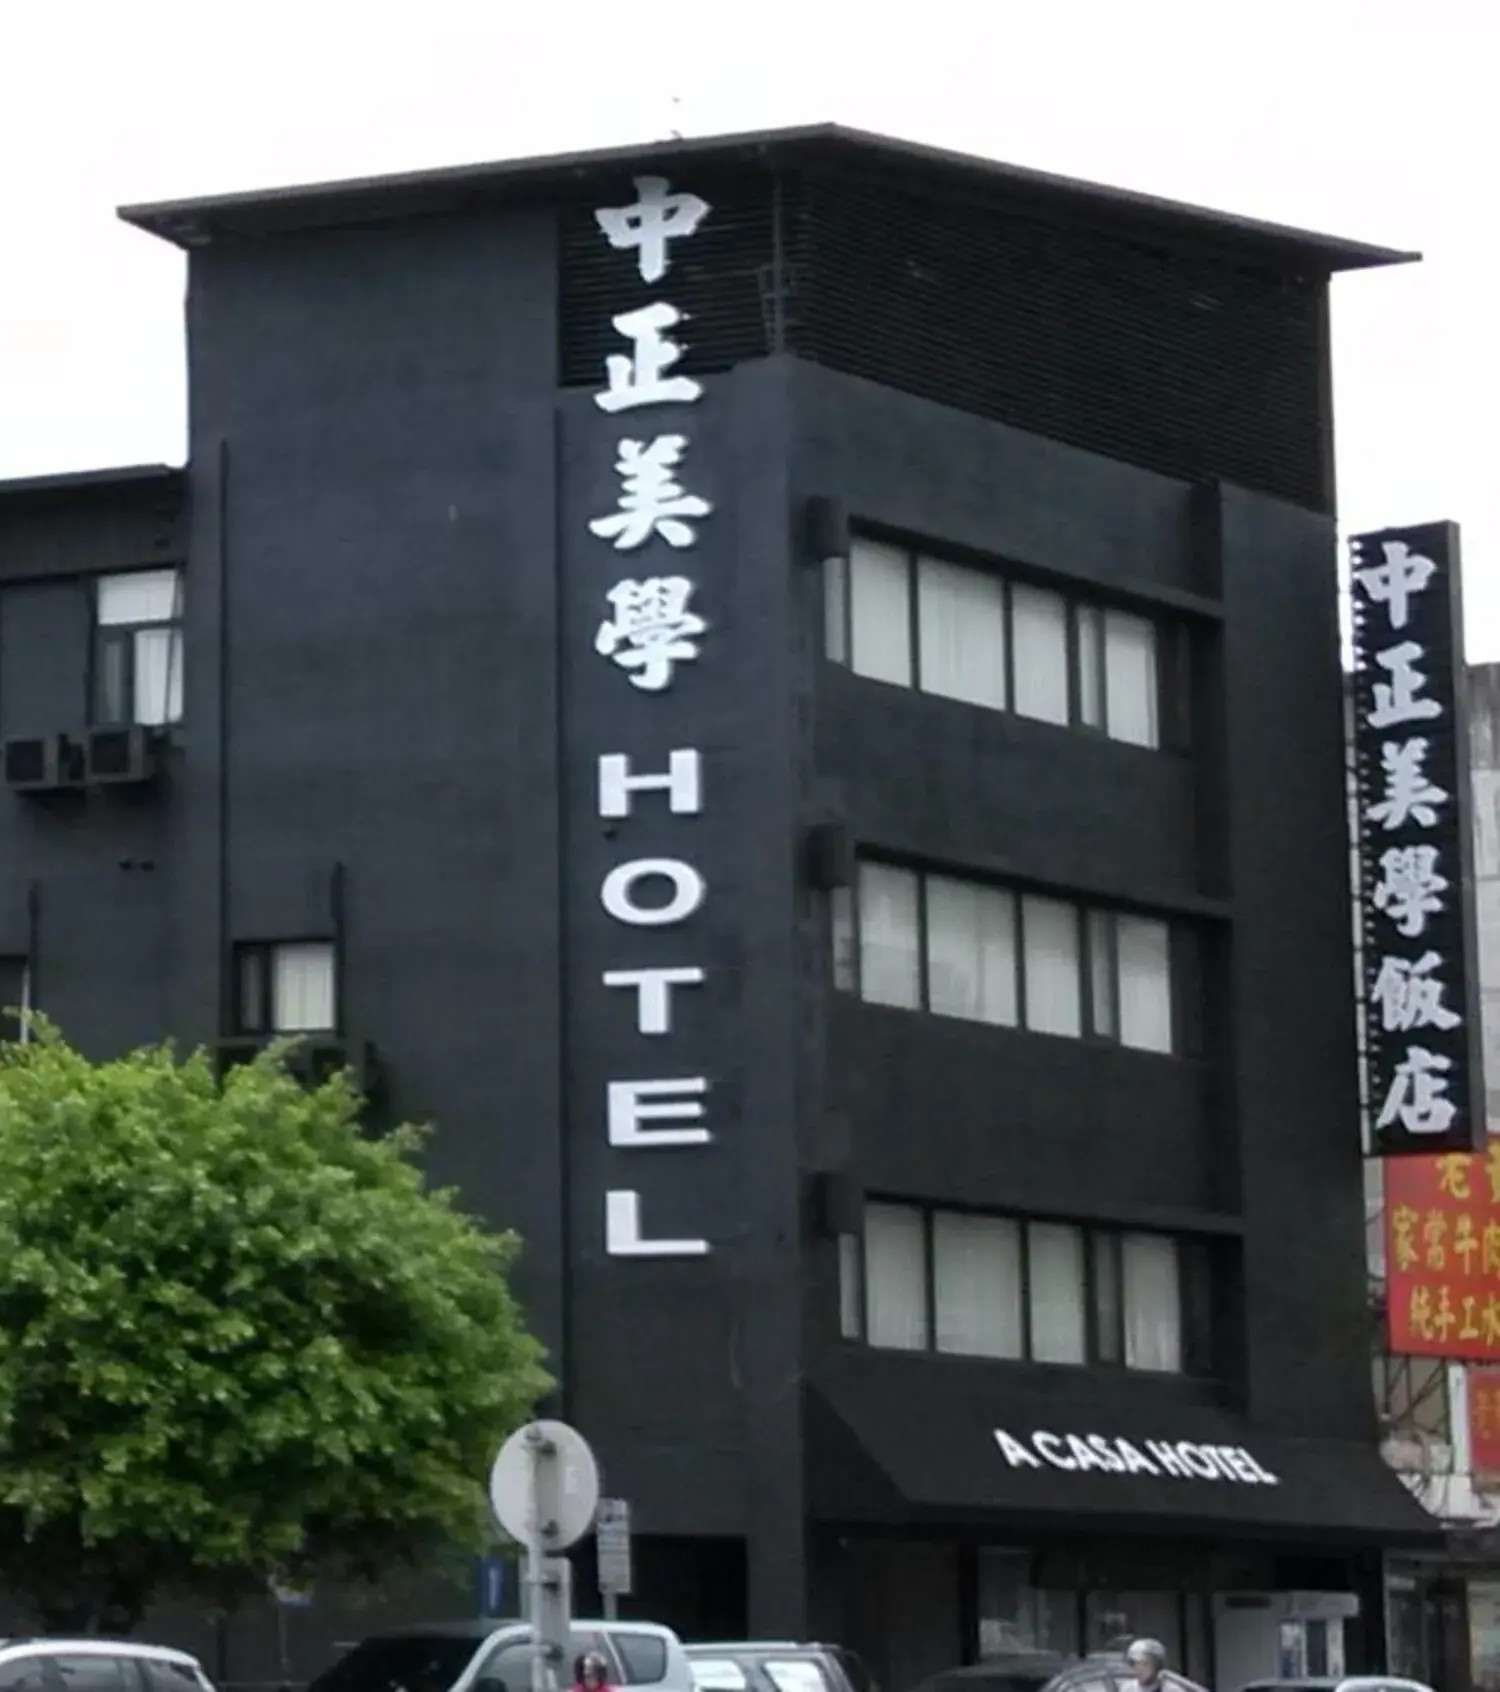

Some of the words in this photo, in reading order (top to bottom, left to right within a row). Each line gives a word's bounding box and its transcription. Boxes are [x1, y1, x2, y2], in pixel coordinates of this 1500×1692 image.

[590, 176, 713, 690] 中正美學
[599, 748, 711, 1256] HOTEL
[1360, 540, 1462, 1136] 中正美學飯店
[994, 1428, 1042, 1468] A
[1031, 1430, 1160, 1476] CASA
[1145, 1439, 1281, 1485] HOTEL
